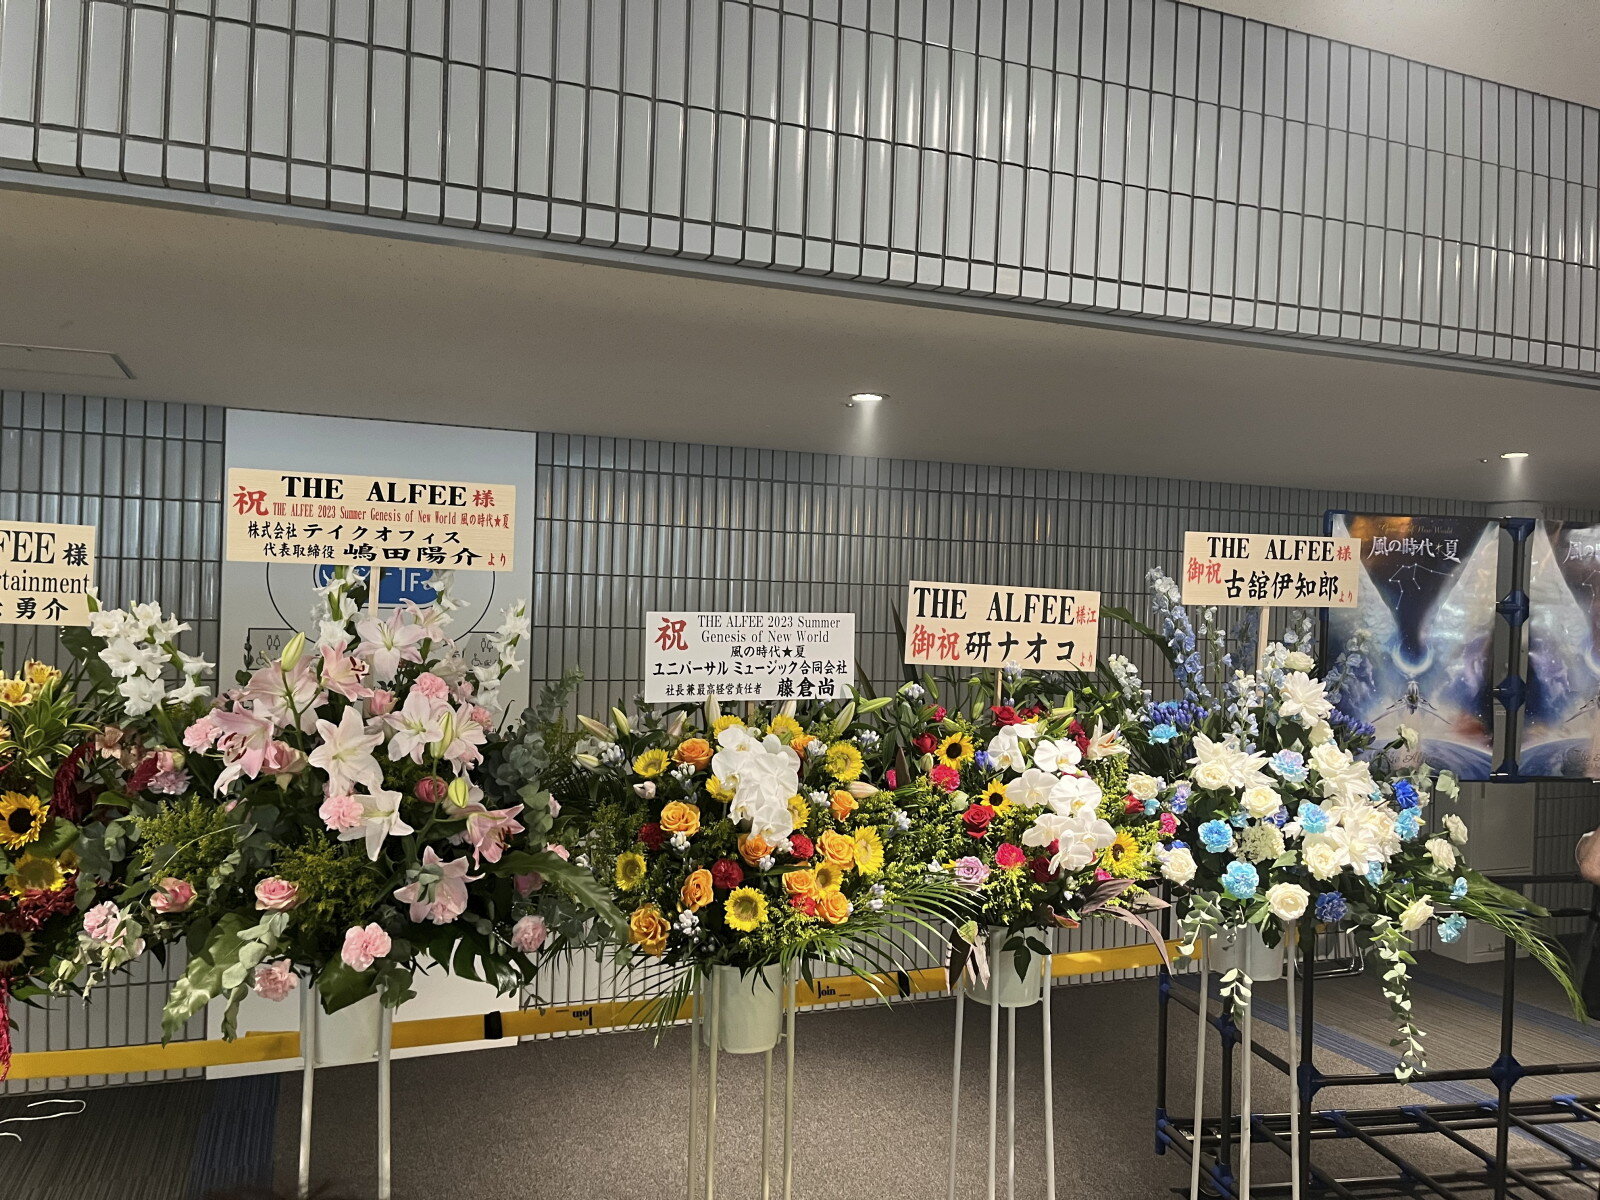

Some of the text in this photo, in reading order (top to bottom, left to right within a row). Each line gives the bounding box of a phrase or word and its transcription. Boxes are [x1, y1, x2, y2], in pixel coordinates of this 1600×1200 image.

[232, 486, 269, 516] 祝
[281, 475, 496, 508] THE ALFEE 様
[273, 502, 287, 516] THE
[291, 503, 314, 518] ALFEE
[318, 504, 336, 519] 2023
[340, 506, 367, 520] Summer
[370, 508, 401, 522] Genesis
[405, 510, 414, 523] of
[418, 510, 431, 524] New
[435, 511, 456, 525] World
[247, 520, 461, 544] 株式会社 テイクオフィス
[62, 542, 89, 567] 様
[263, 541, 507, 567] 代表取締役 嶋田陽介 より
[1206, 536, 1352, 562] THE ALFEE 様
[0, 568, 90, 594] tainment
[1187, 556, 1222, 585] 御祝
[913, 587, 1097, 625] THE ALFEE 様江
[1339, 590, 1353, 603] より
[654, 616, 689, 651] 祝
[697, 615, 841, 629] THE ALFEE 2023 Summer
[701, 630, 829, 643] Genesis of New World
[910, 623, 1093, 667] 御祝 研ナオコ より
[776, 676, 835, 698] 藤倉尚
[817, 980, 836, 999] Join
